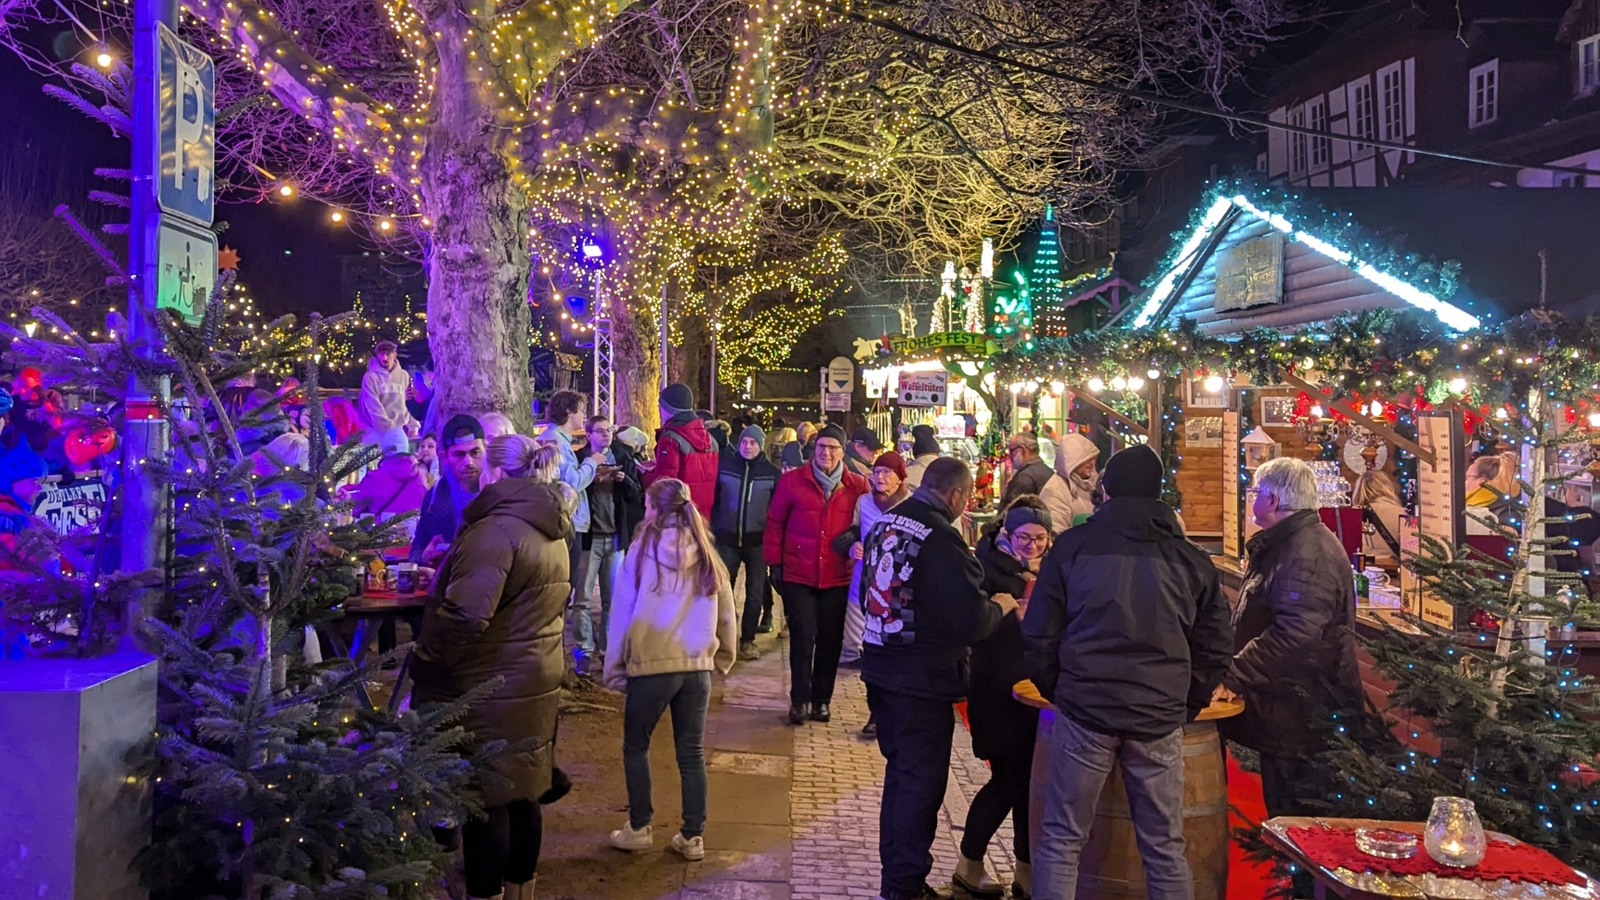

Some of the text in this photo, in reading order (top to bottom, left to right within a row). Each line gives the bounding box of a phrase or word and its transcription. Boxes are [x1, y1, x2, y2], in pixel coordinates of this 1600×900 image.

[174, 56, 205, 190] P
[893, 332, 979, 352] FROHES FEST
[901, 381, 944, 393] Waffeltüten
[895, 515, 933, 537] around
